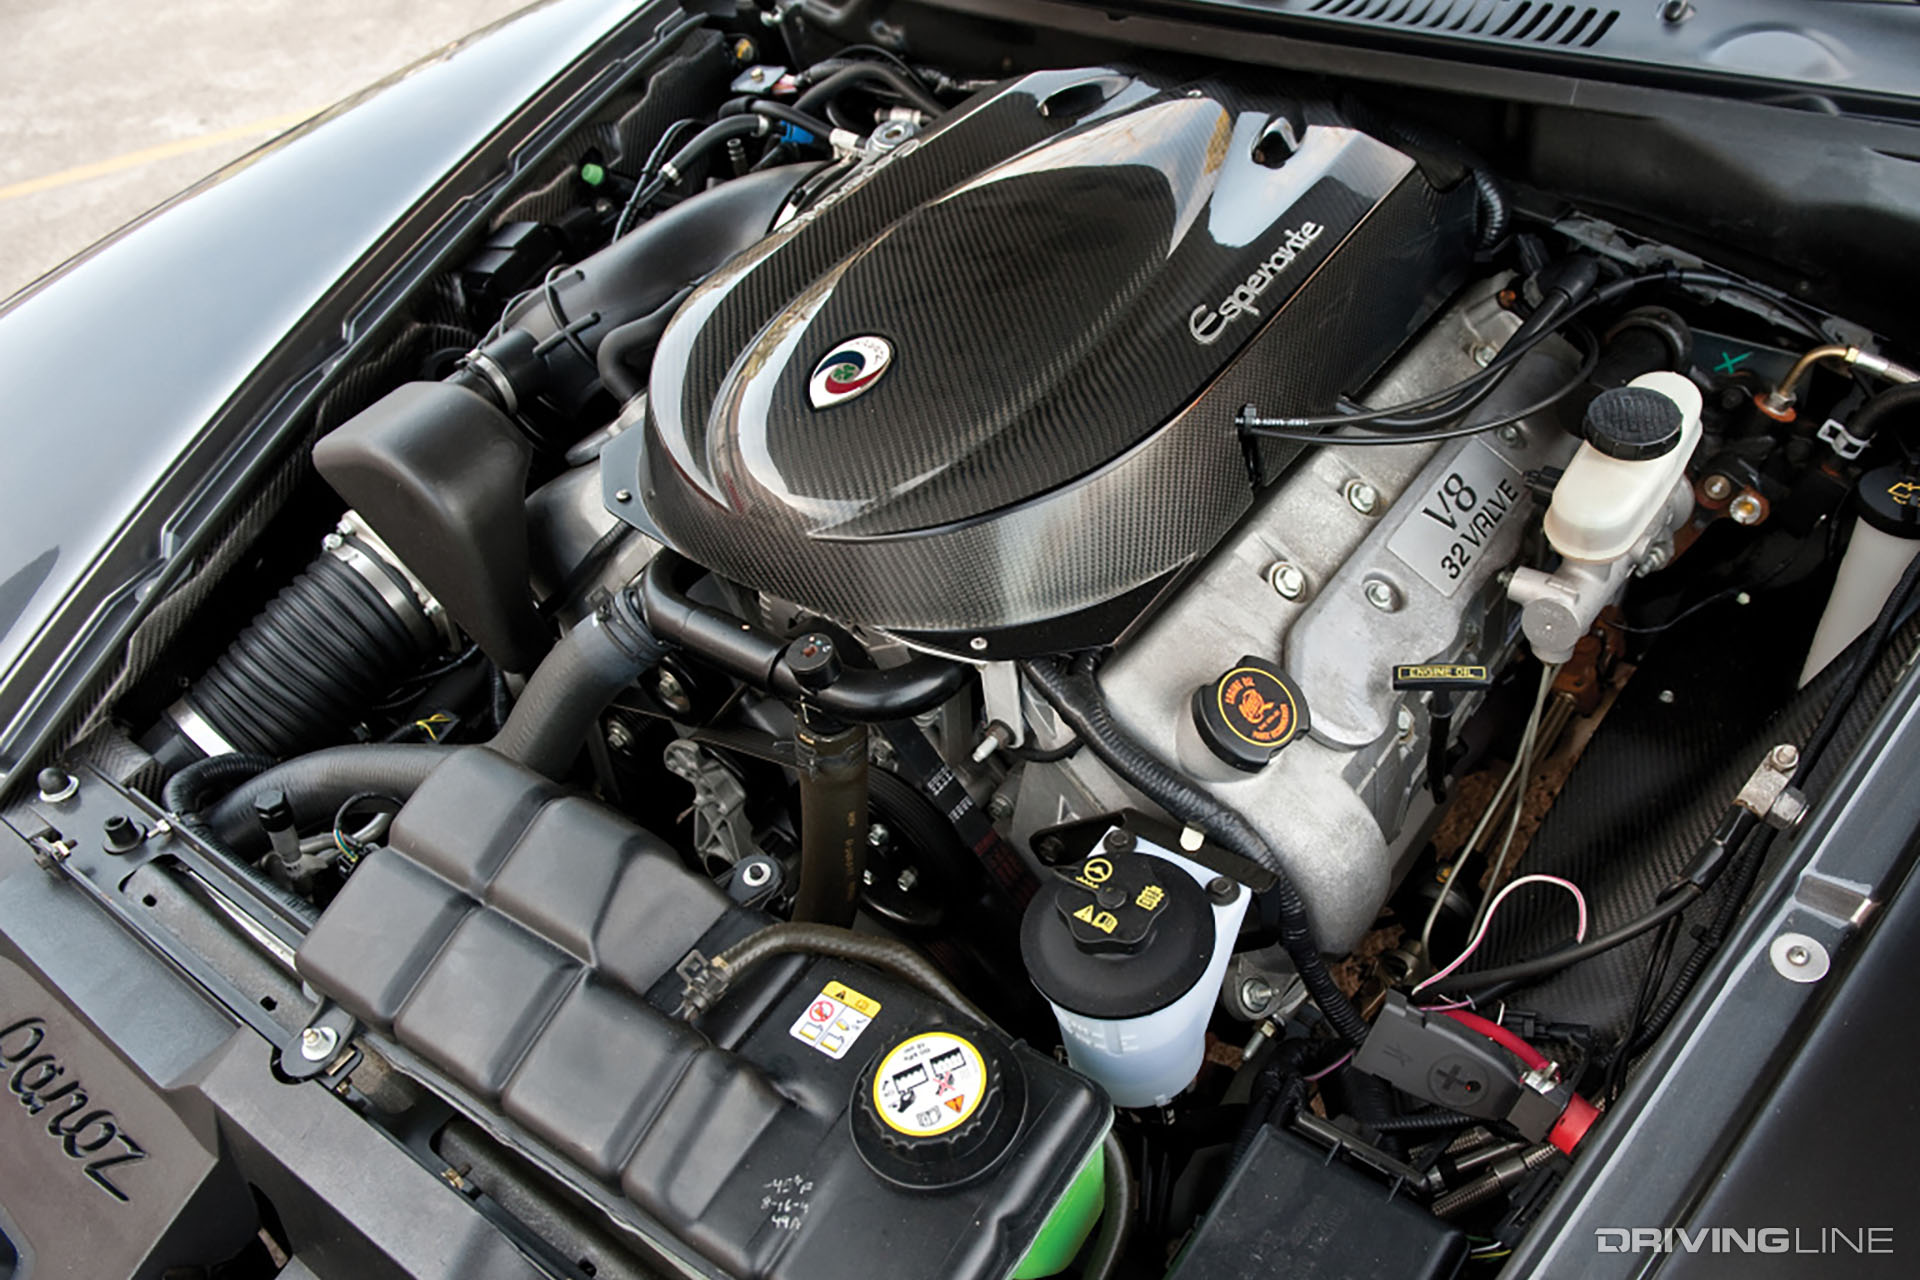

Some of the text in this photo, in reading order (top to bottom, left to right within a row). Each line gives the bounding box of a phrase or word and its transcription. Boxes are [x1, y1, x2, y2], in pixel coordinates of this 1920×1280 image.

[1188, 220, 1325, 345] Esperante
[1422, 472, 1478, 531] V8
[1441, 478, 1520, 579] 32 VALVE
